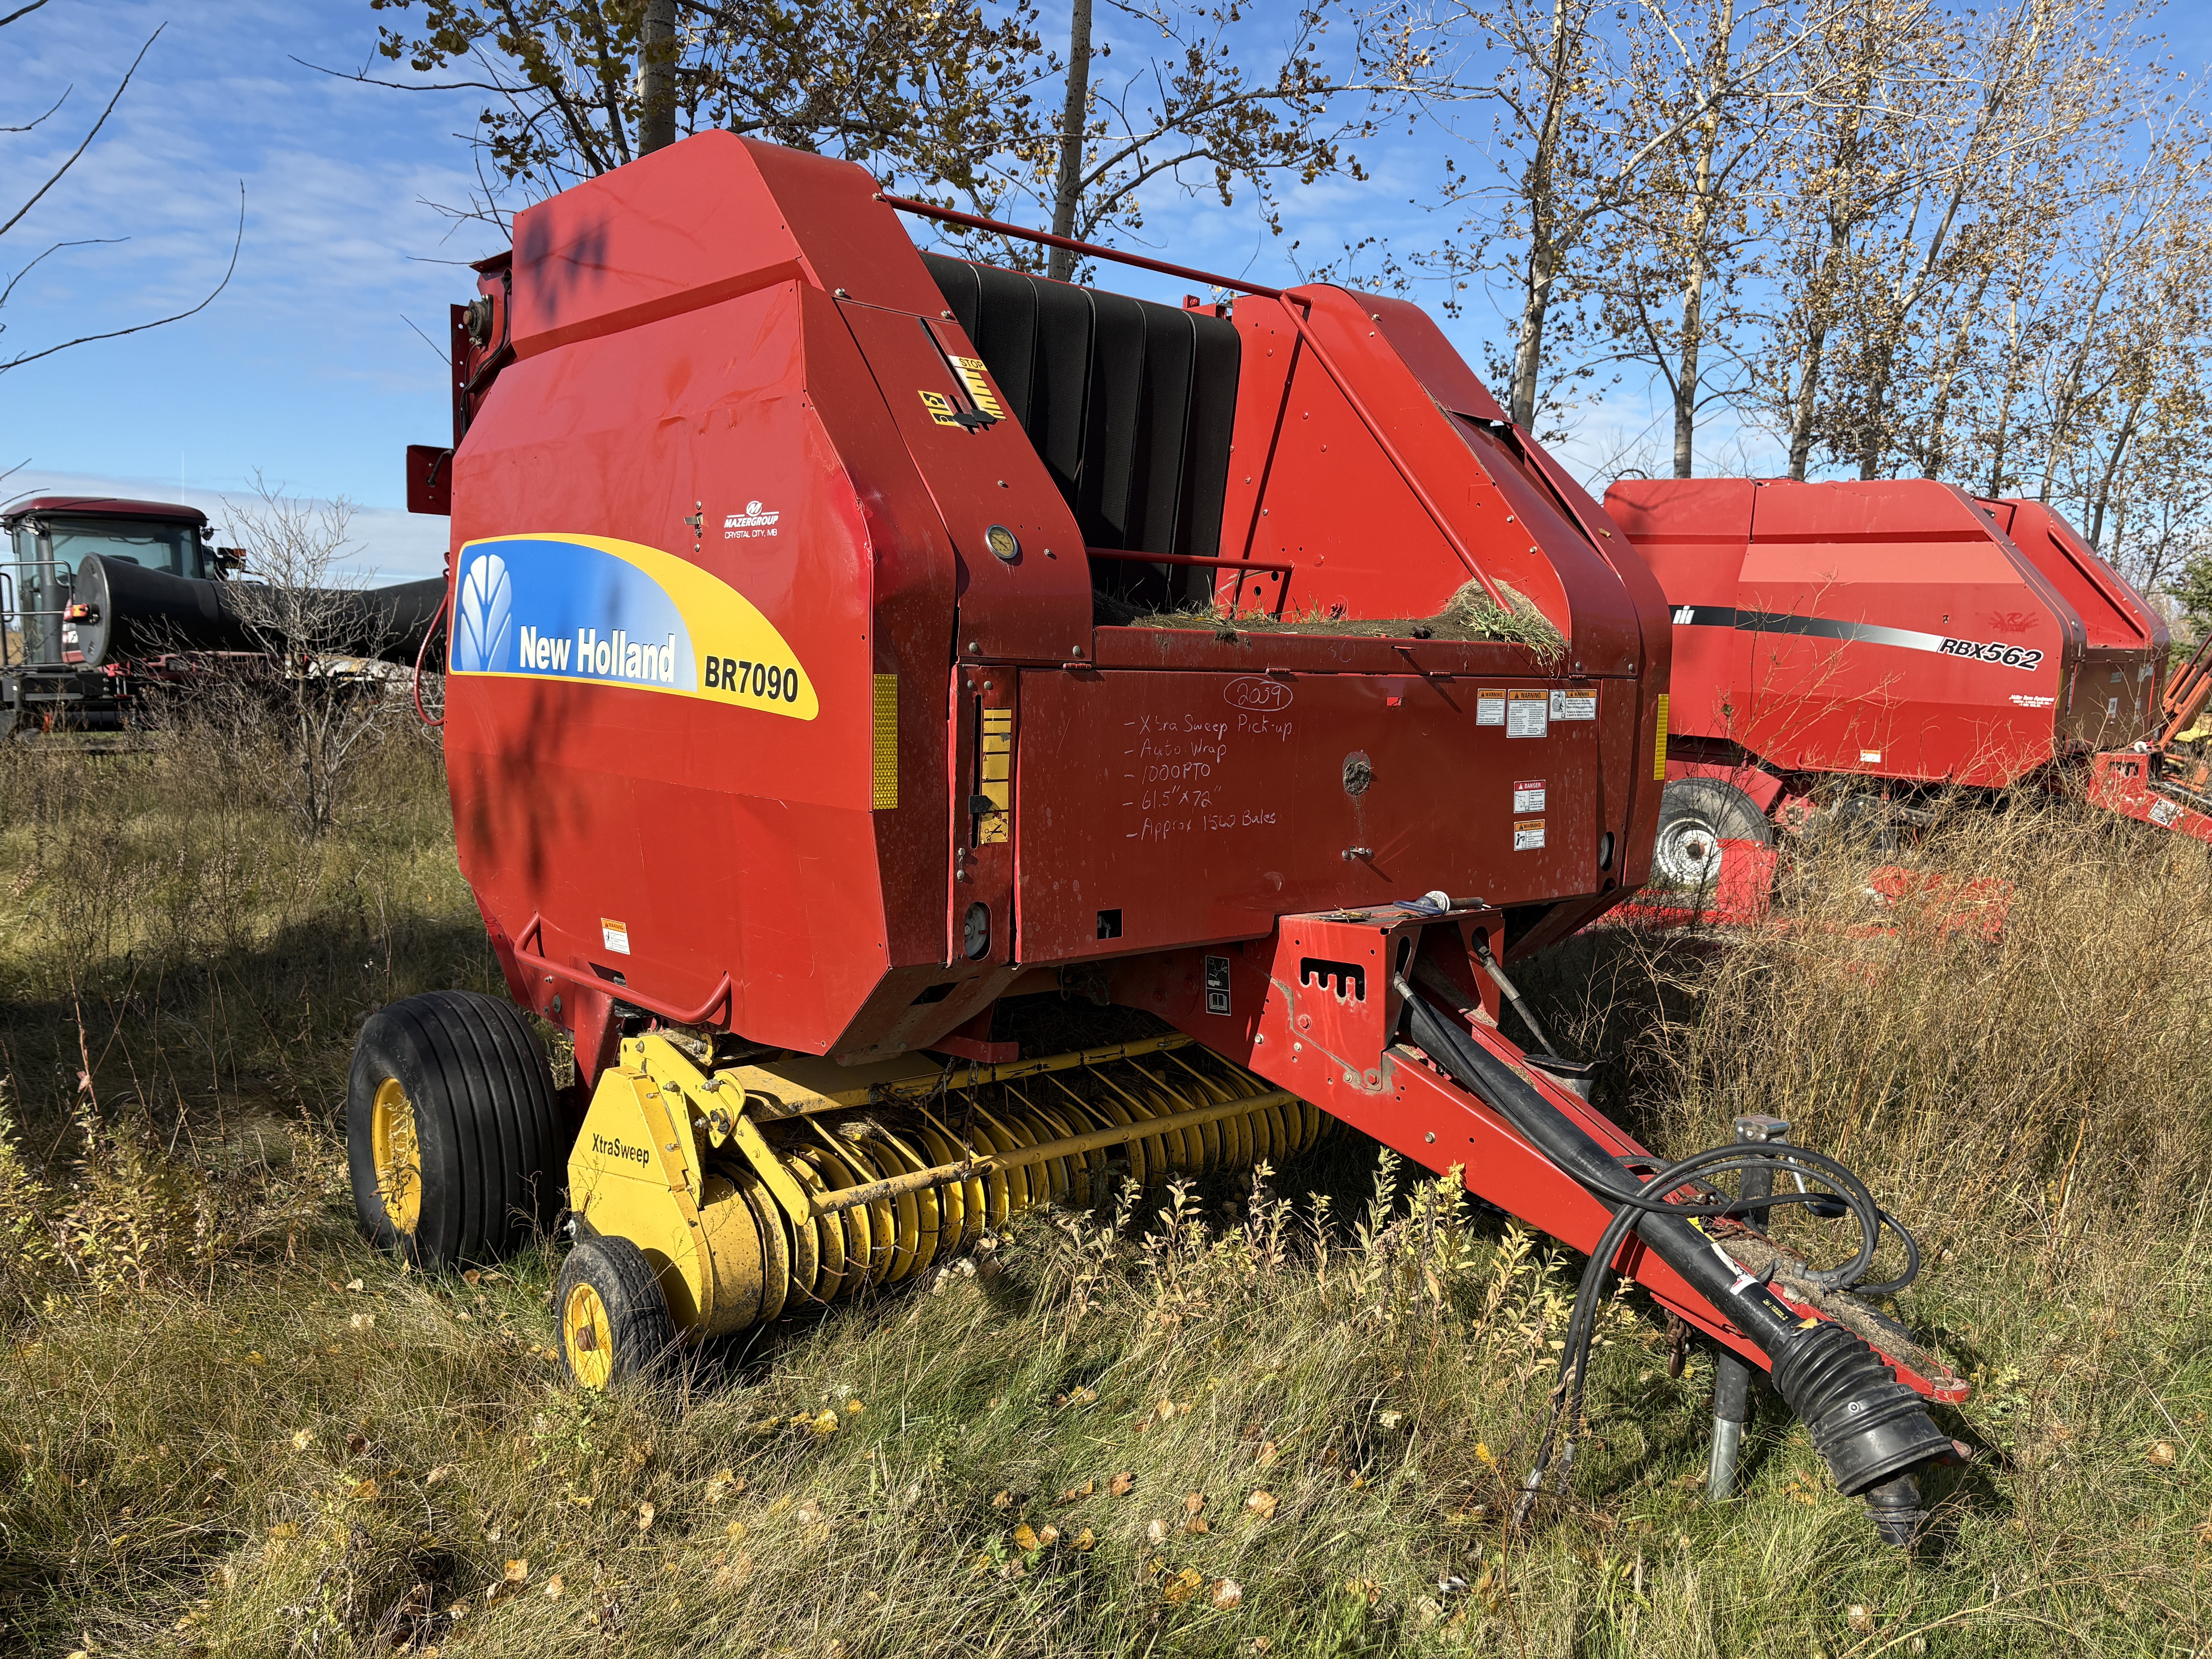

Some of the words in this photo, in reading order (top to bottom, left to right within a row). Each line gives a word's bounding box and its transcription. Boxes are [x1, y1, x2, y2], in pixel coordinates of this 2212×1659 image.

[958, 358, 983, 369] STOP
[724, 515, 779, 528] MAZERGROUP
[725, 531, 751, 539] CRYSTAL
[520, 625, 571, 670] New
[577, 627, 676, 683] Holland
[1938, 638, 2042, 670] RBX562
[705, 655, 799, 703] BR7090
[1183, 714, 1228, 740] Sweep
[1191, 738, 1227, 764] Wrap
[1242, 808, 1276, 826] Bales
[592, 1133, 649, 1169] XtraSweep
